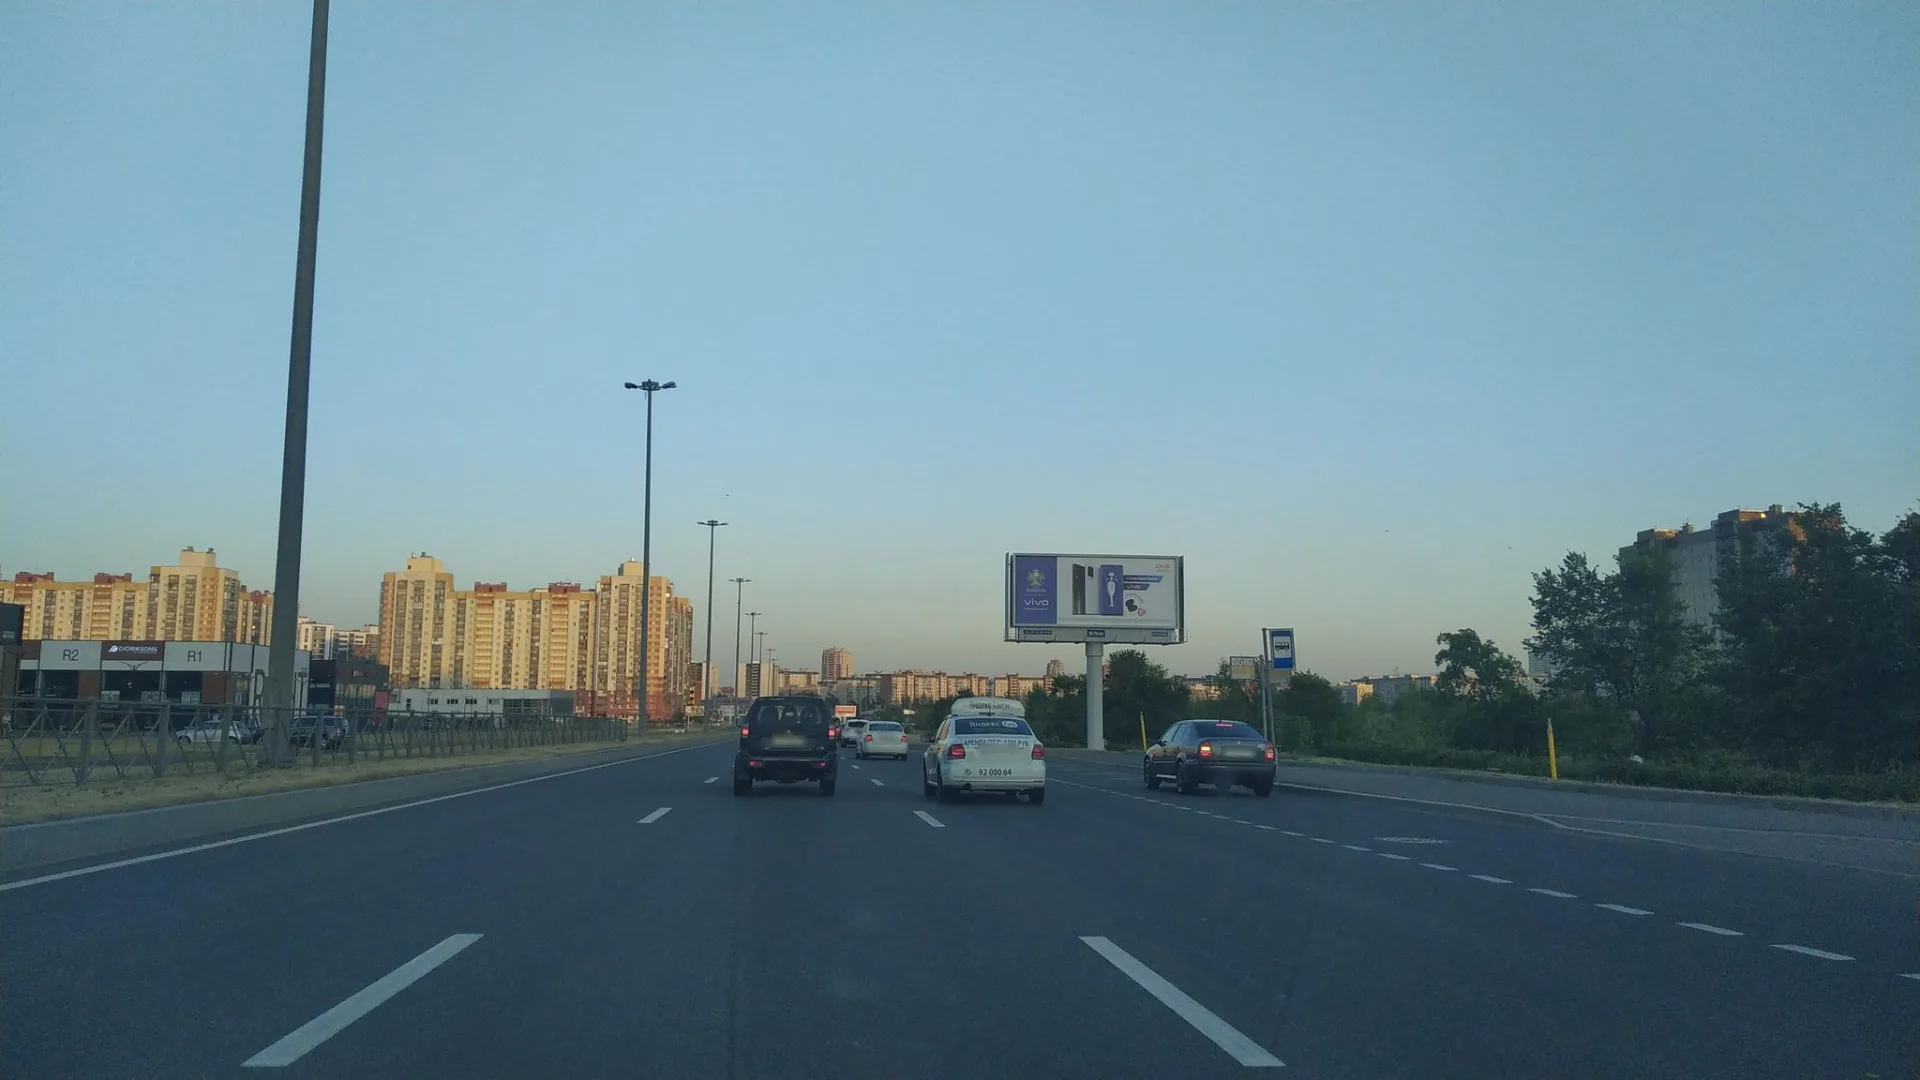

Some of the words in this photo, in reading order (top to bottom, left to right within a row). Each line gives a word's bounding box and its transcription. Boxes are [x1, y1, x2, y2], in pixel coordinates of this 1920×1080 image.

[1024, 598, 1049, 606] vivo
[118, 645, 158, 653] DIDRIKSONS
[62, 649, 80, 661] R2
[187, 650, 203, 662] R1
[978, 768, 988, 776] 92
[989, 768, 1002, 776] 000
[1003, 768, 1012, 776] 64
